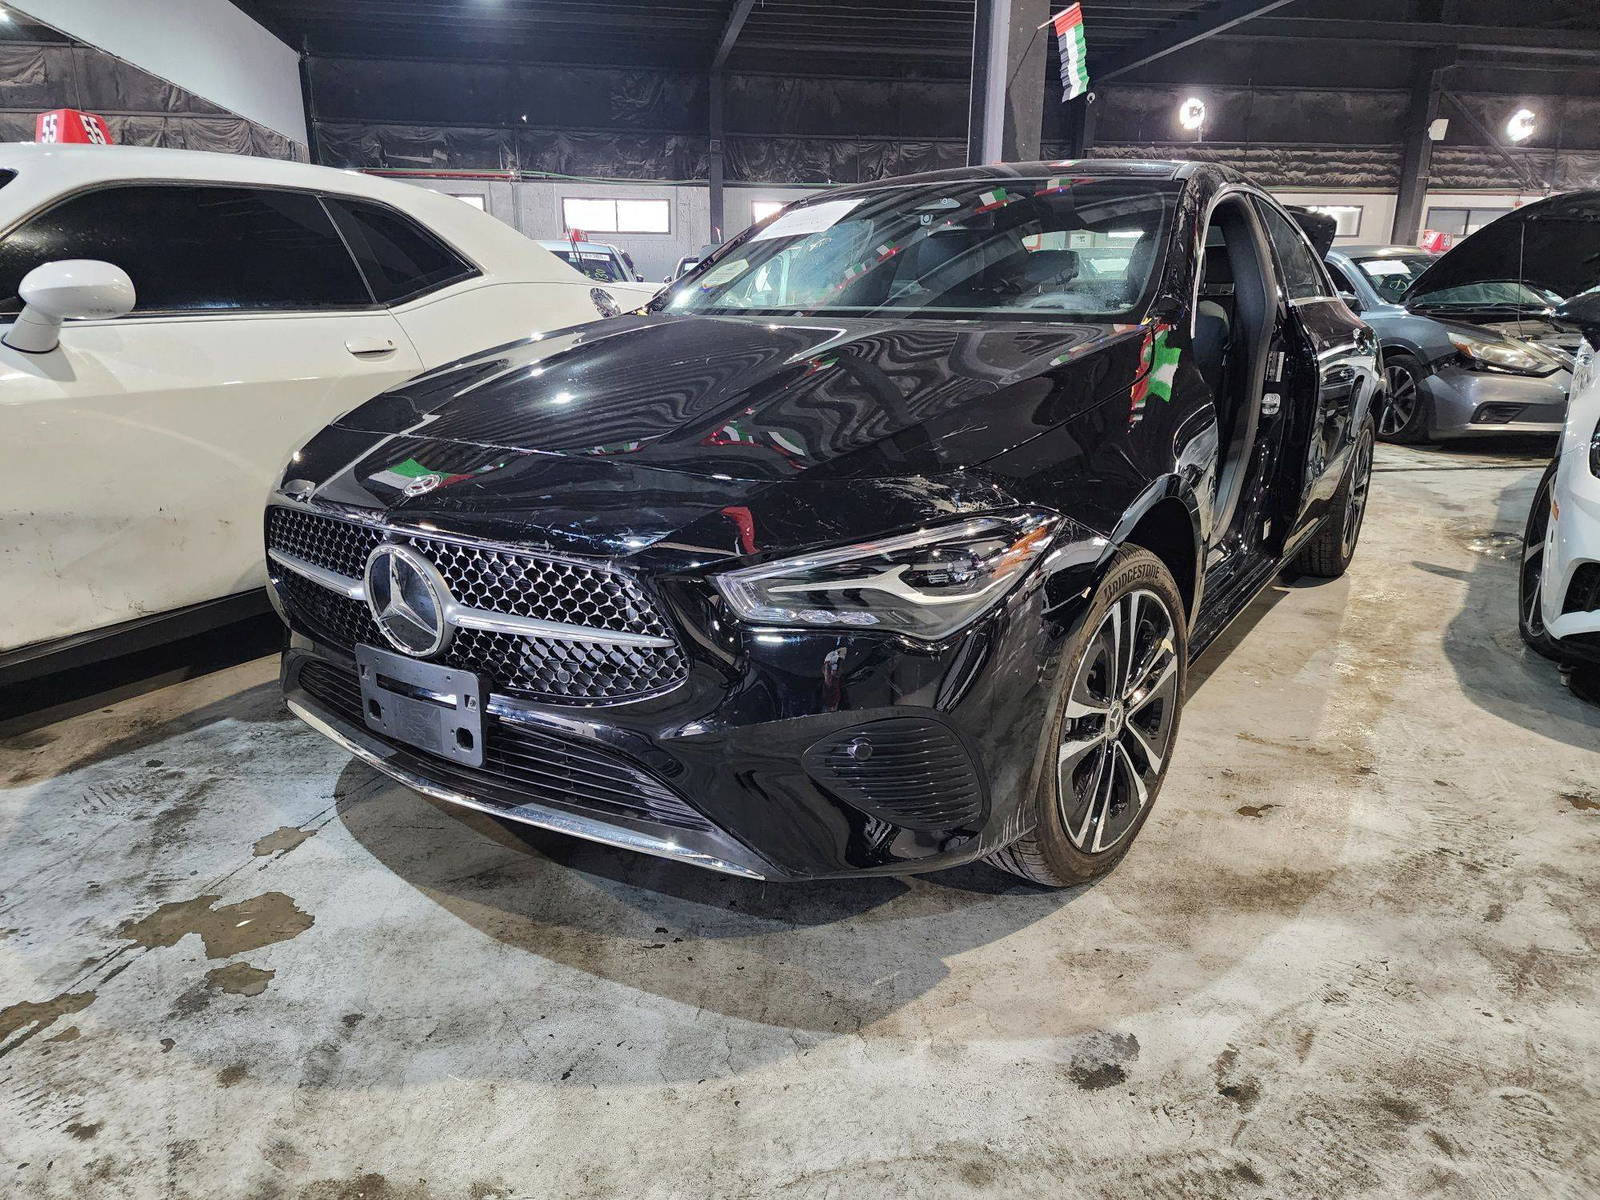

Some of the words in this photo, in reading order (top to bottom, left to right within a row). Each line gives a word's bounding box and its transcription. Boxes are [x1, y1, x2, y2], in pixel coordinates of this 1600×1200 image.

[42, 114, 58, 144] 55
[79, 114, 106, 145] 55
[1103, 563, 1160, 603] BRIDGESTONE
